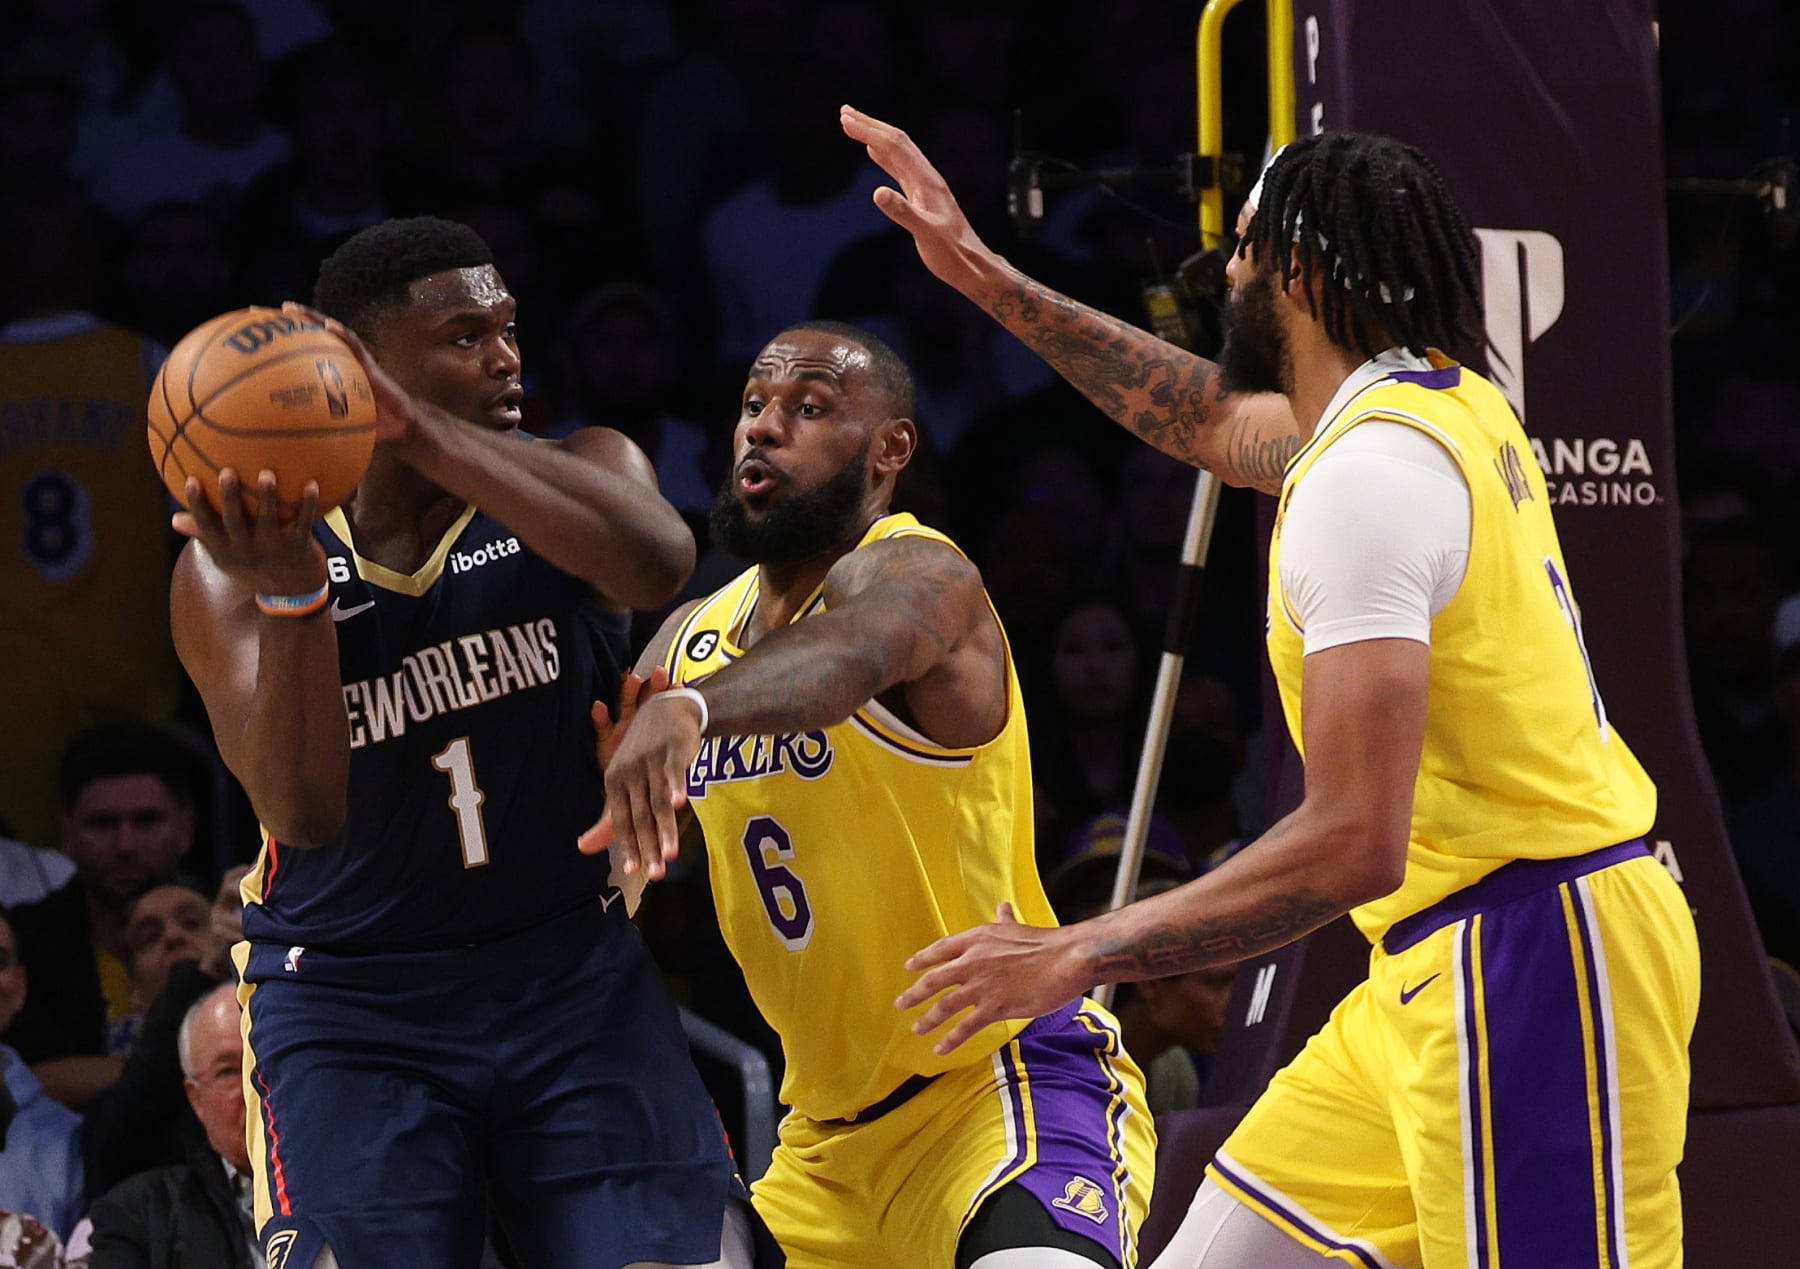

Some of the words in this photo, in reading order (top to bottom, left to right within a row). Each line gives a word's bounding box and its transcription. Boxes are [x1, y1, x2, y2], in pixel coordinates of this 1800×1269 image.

[24, 472, 95, 583] 8
[450, 536, 521, 575] ibotta
[342, 669, 407, 751] EW
[400, 616, 561, 724] ORLEANS
[690, 631, 719, 662] 6
[430, 735, 491, 869] 1
[741, 814, 816, 952] 6
